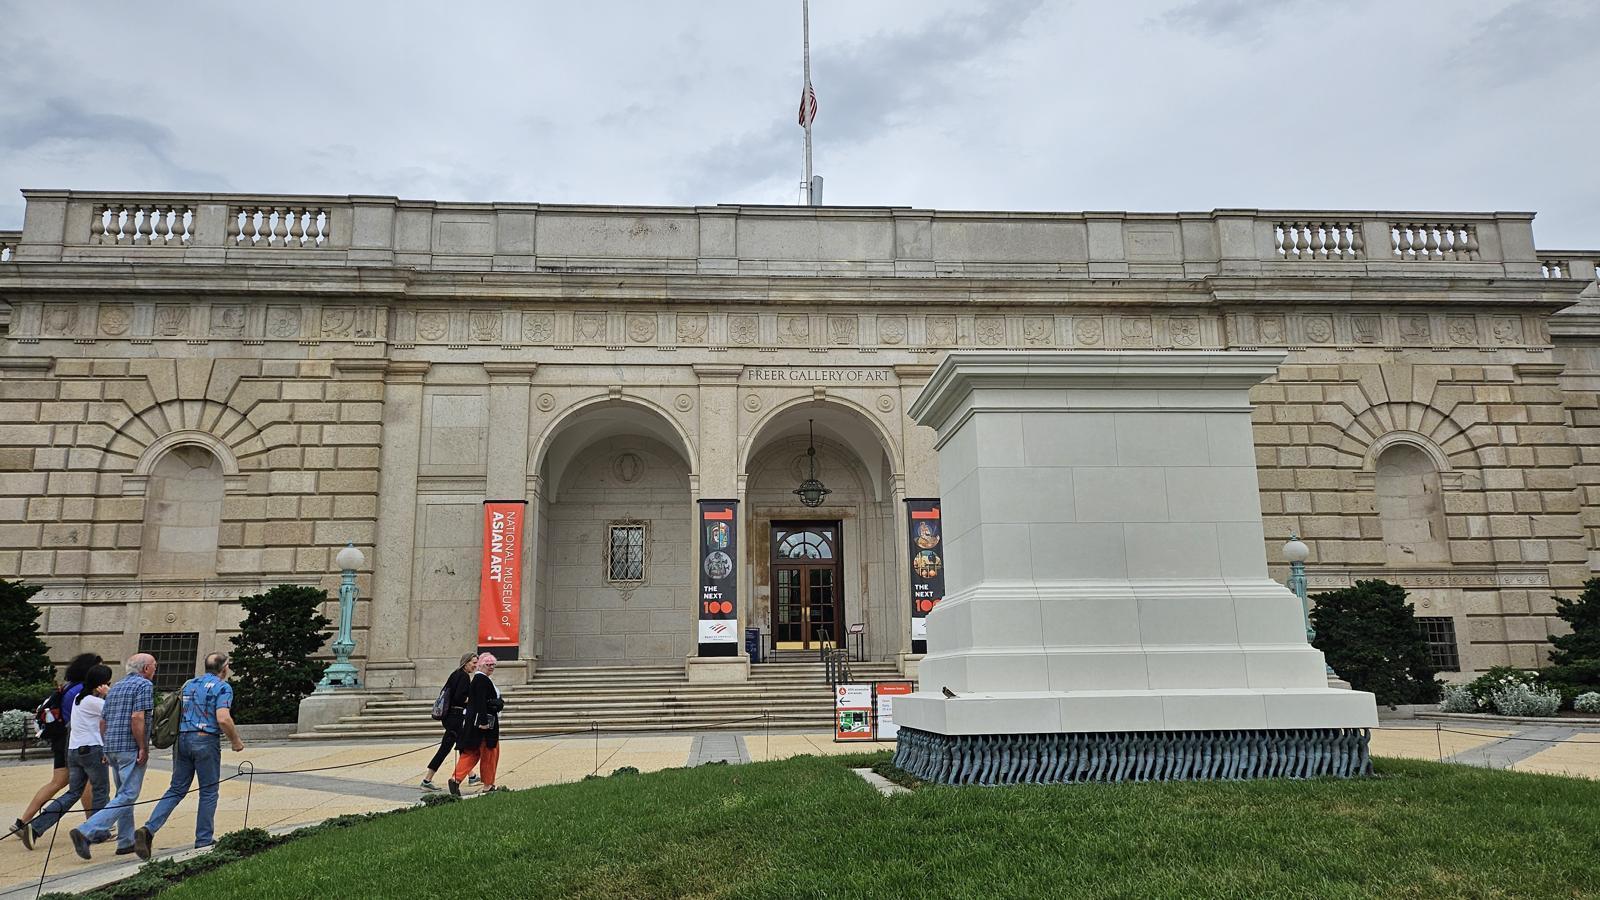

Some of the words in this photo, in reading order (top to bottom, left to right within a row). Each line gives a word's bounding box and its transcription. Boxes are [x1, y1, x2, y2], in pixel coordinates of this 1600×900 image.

[748, 370, 787, 381] FREER
[789, 370, 844, 381] GALLERY
[846, 370, 863, 381] OF
[866, 370, 889, 381] ART
[491, 511, 504, 553] ASIAN
[504, 511, 516, 564] NATIONAL
[490, 554, 503, 583] ART
[502, 567, 514, 613] MUSEUM
[704, 601, 733, 614] 100
